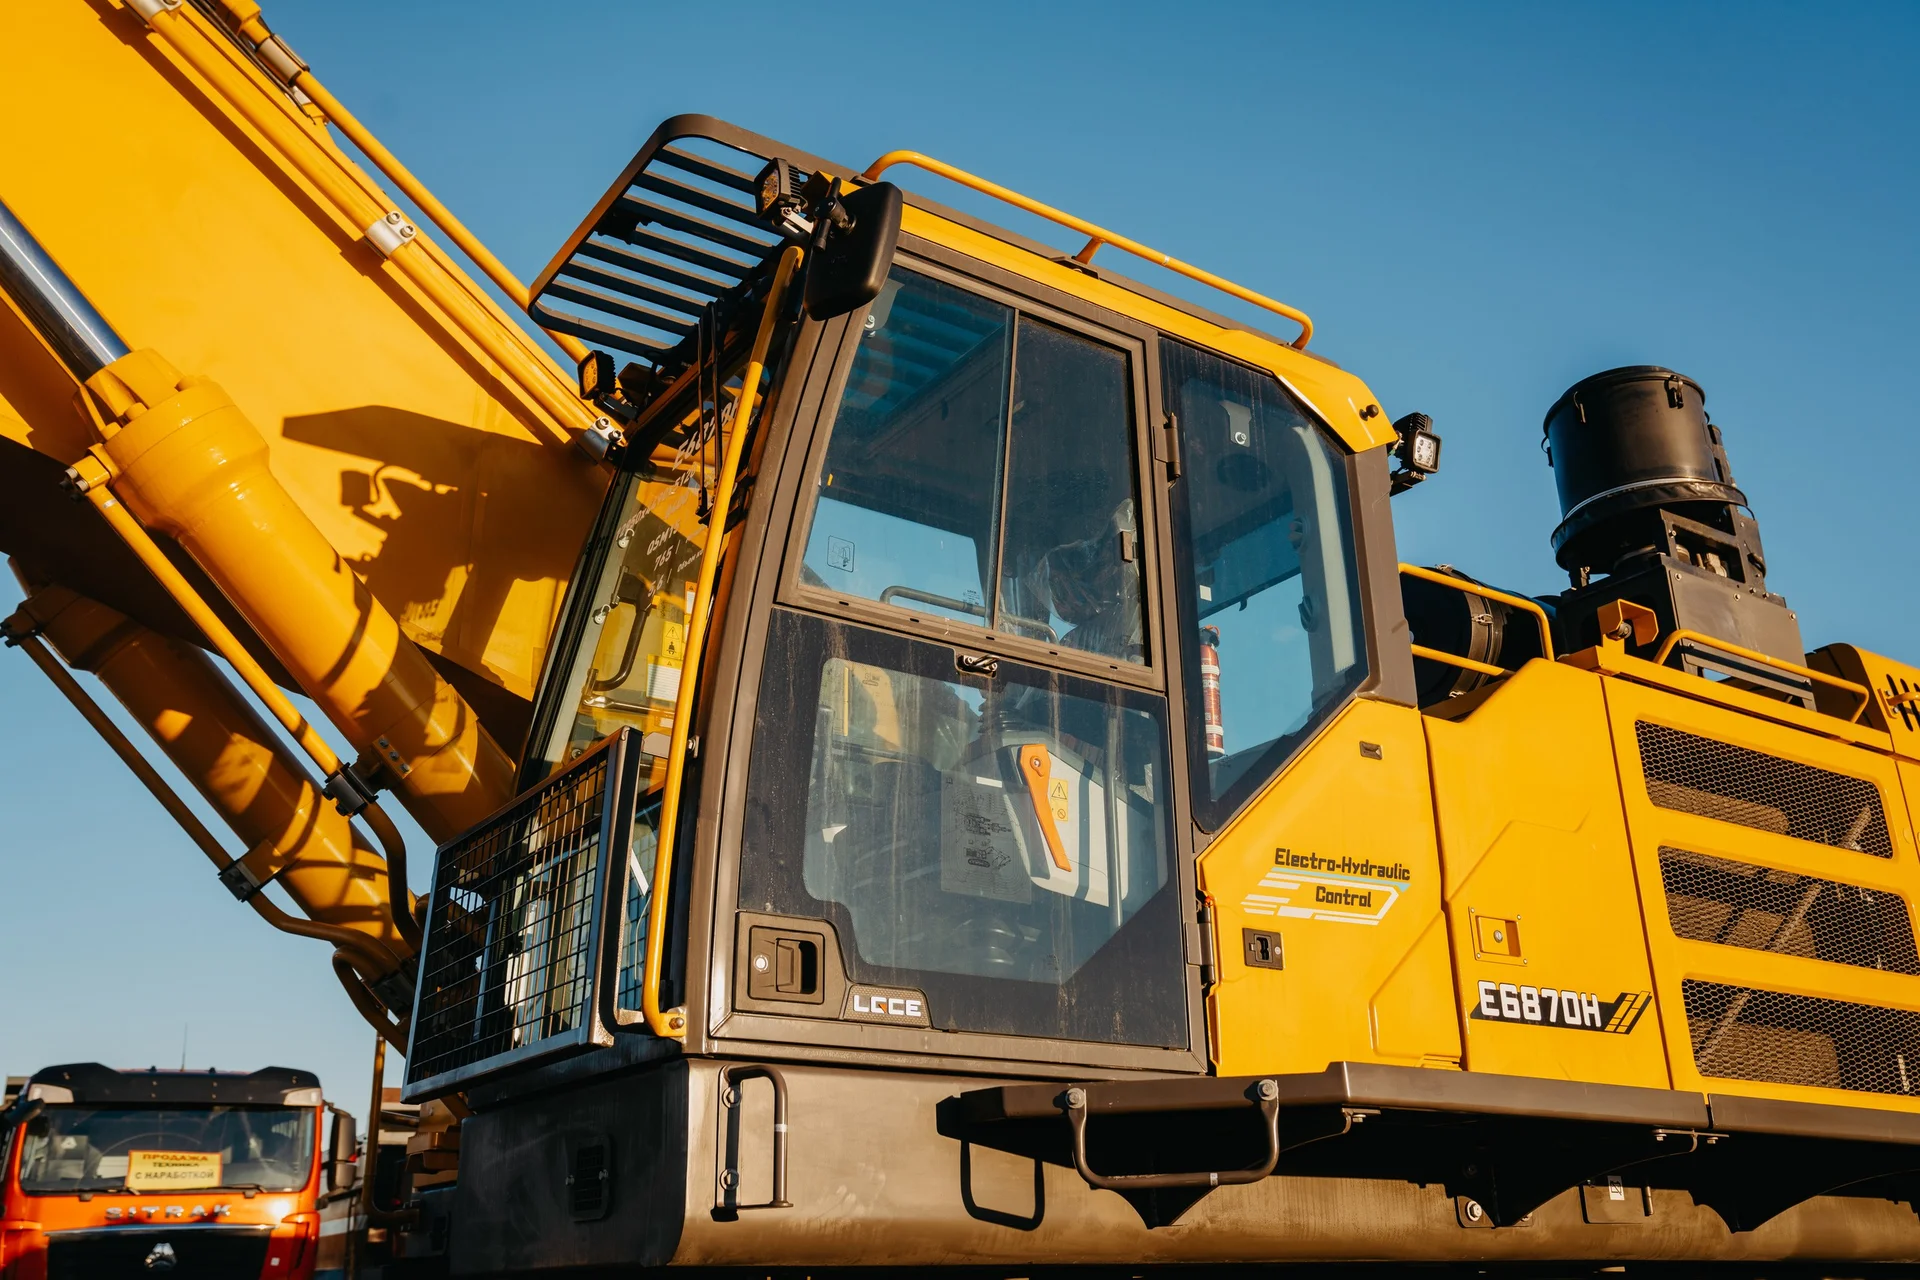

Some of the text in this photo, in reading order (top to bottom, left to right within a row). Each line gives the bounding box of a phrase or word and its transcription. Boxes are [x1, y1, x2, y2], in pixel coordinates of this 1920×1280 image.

[654, 545, 674, 571] 765
[1275, 848, 1410, 880] Electro-Hydraulic
[1315, 886, 1371, 907] Control
[853, 995, 921, 1016] LGCE
[1478, 980, 1601, 1027] E6870H
[143, 1153, 208, 1161] ПРОДАЖА
[135, 1169, 214, 1179] С НАРАБОТКОЙ
[105, 1204, 232, 1220] SITRAK
